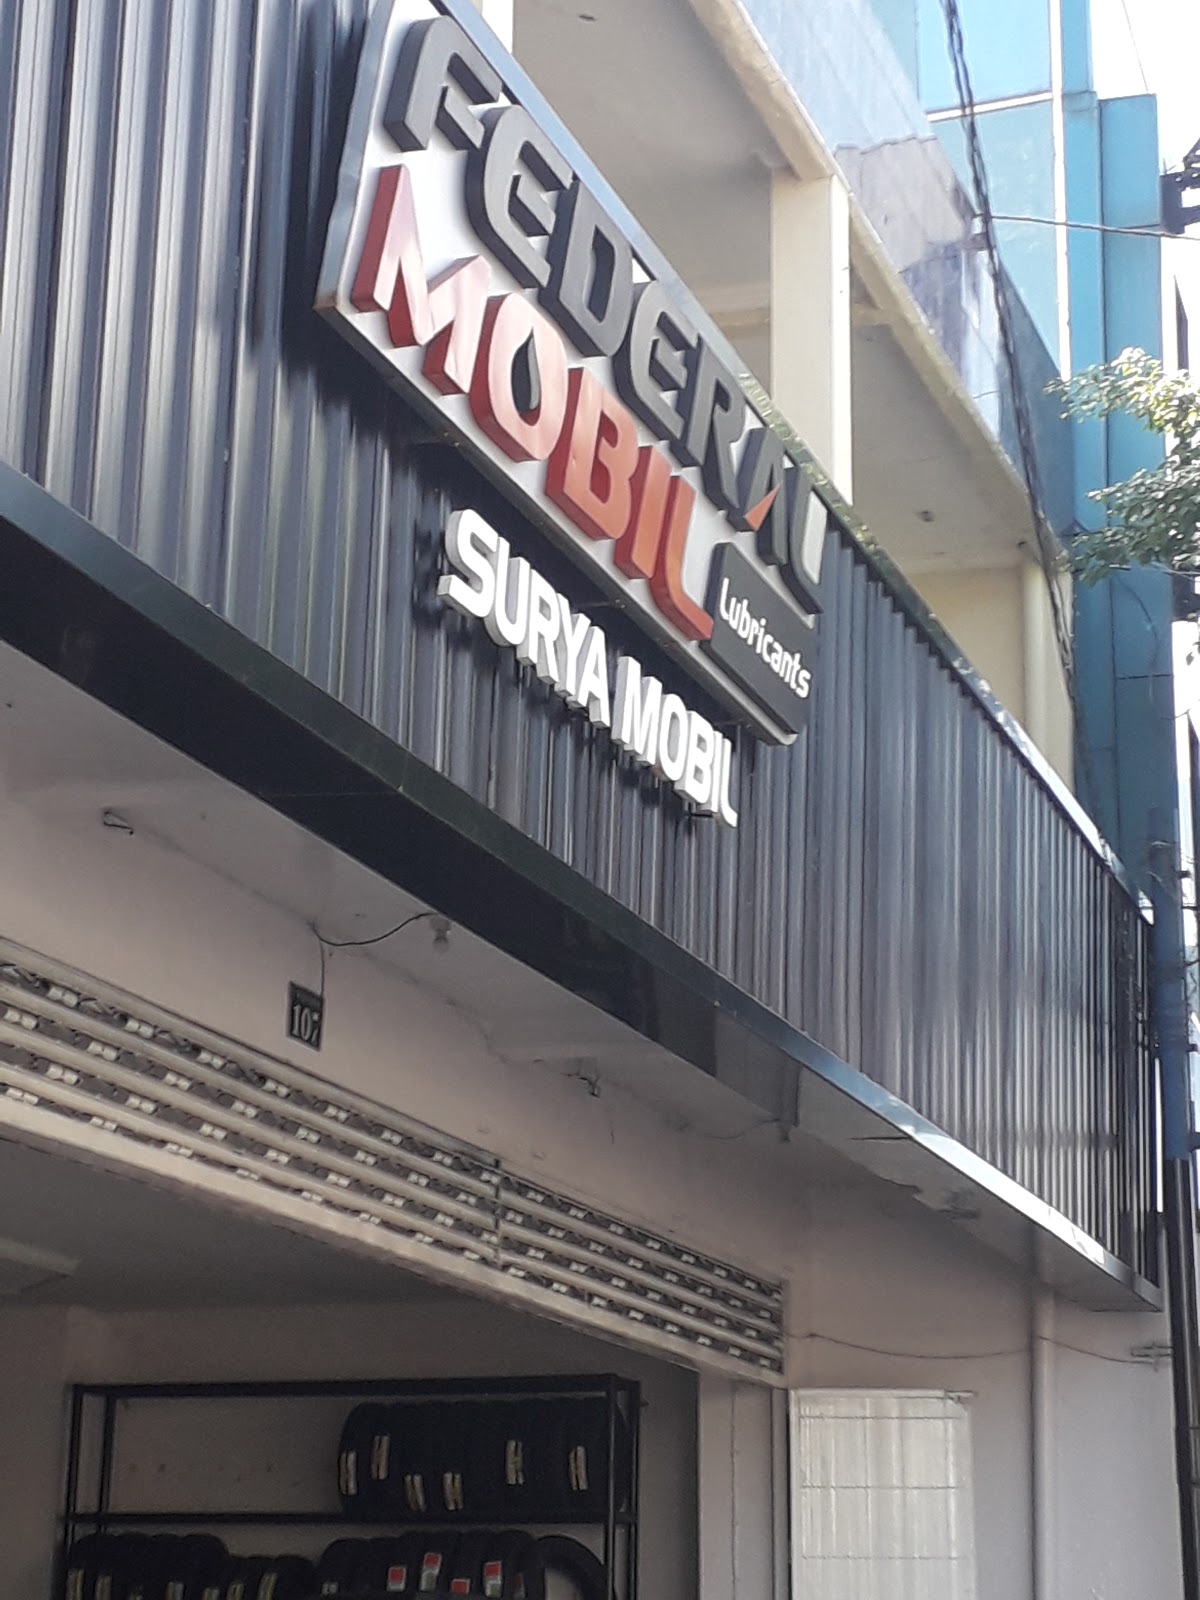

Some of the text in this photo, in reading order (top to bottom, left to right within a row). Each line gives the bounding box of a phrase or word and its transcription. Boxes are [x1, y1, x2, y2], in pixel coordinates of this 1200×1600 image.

[352, 164, 714, 641] MOBIL
[384, 15, 824, 614] FEDERAL
[438, 509, 738, 828] SURYA MOBIL
[719, 577, 812, 698] Lubricants
